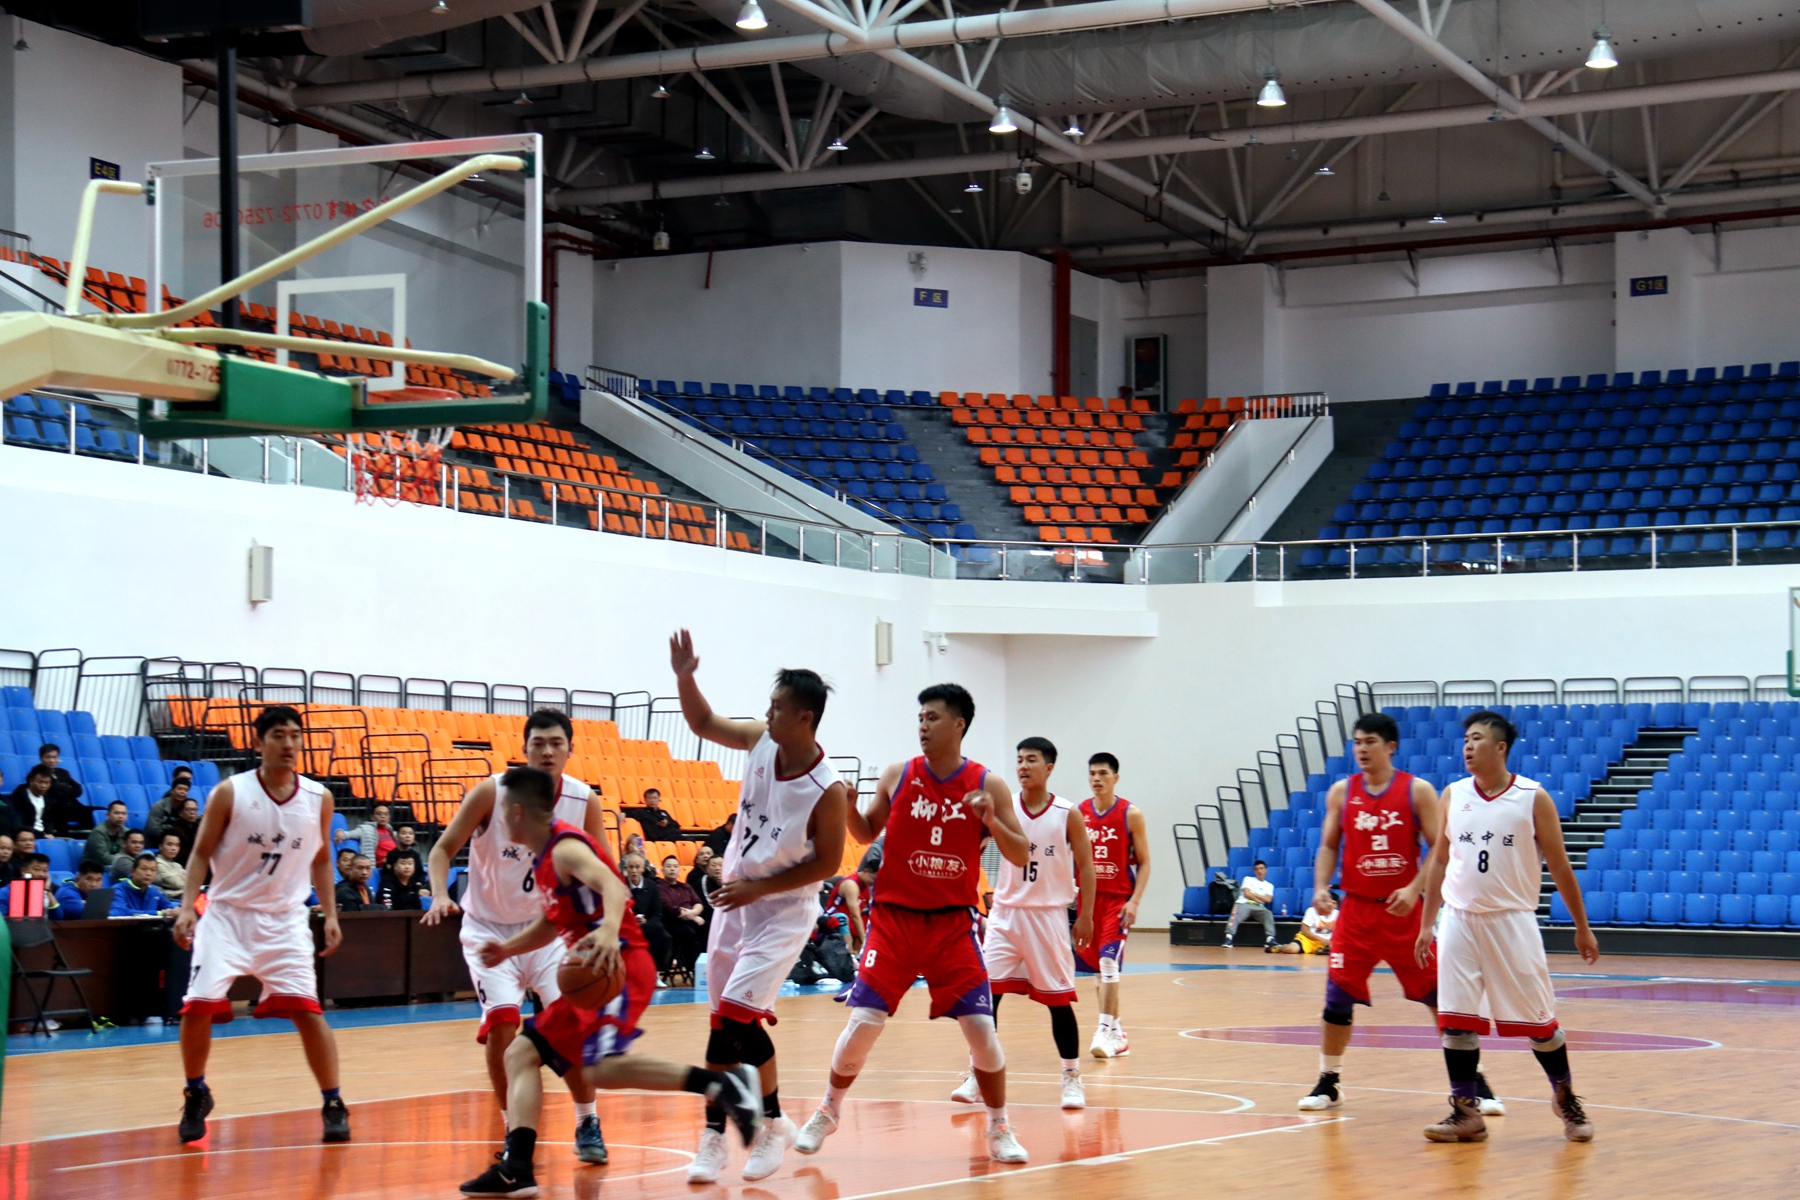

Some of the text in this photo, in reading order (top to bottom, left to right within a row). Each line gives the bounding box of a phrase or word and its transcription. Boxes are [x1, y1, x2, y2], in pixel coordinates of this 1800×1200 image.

[1635, 279, 1665, 291] G1区
[911, 794, 966, 823] 柳江
[1354, 809, 1404, 831] 柳江
[247, 833, 303, 850] 城中区
[931, 826, 943, 846] 8
[1371, 834, 1389, 851] 21
[1459, 830, 1515, 847] 城中区
[1094, 846, 1108, 859] 23
[1478, 850, 1489, 873] 8
[258, 852, 282, 875] 77
[1023, 861, 1038, 883] 15
[522, 868, 534, 892] 6
[865, 950, 877, 967] 8
